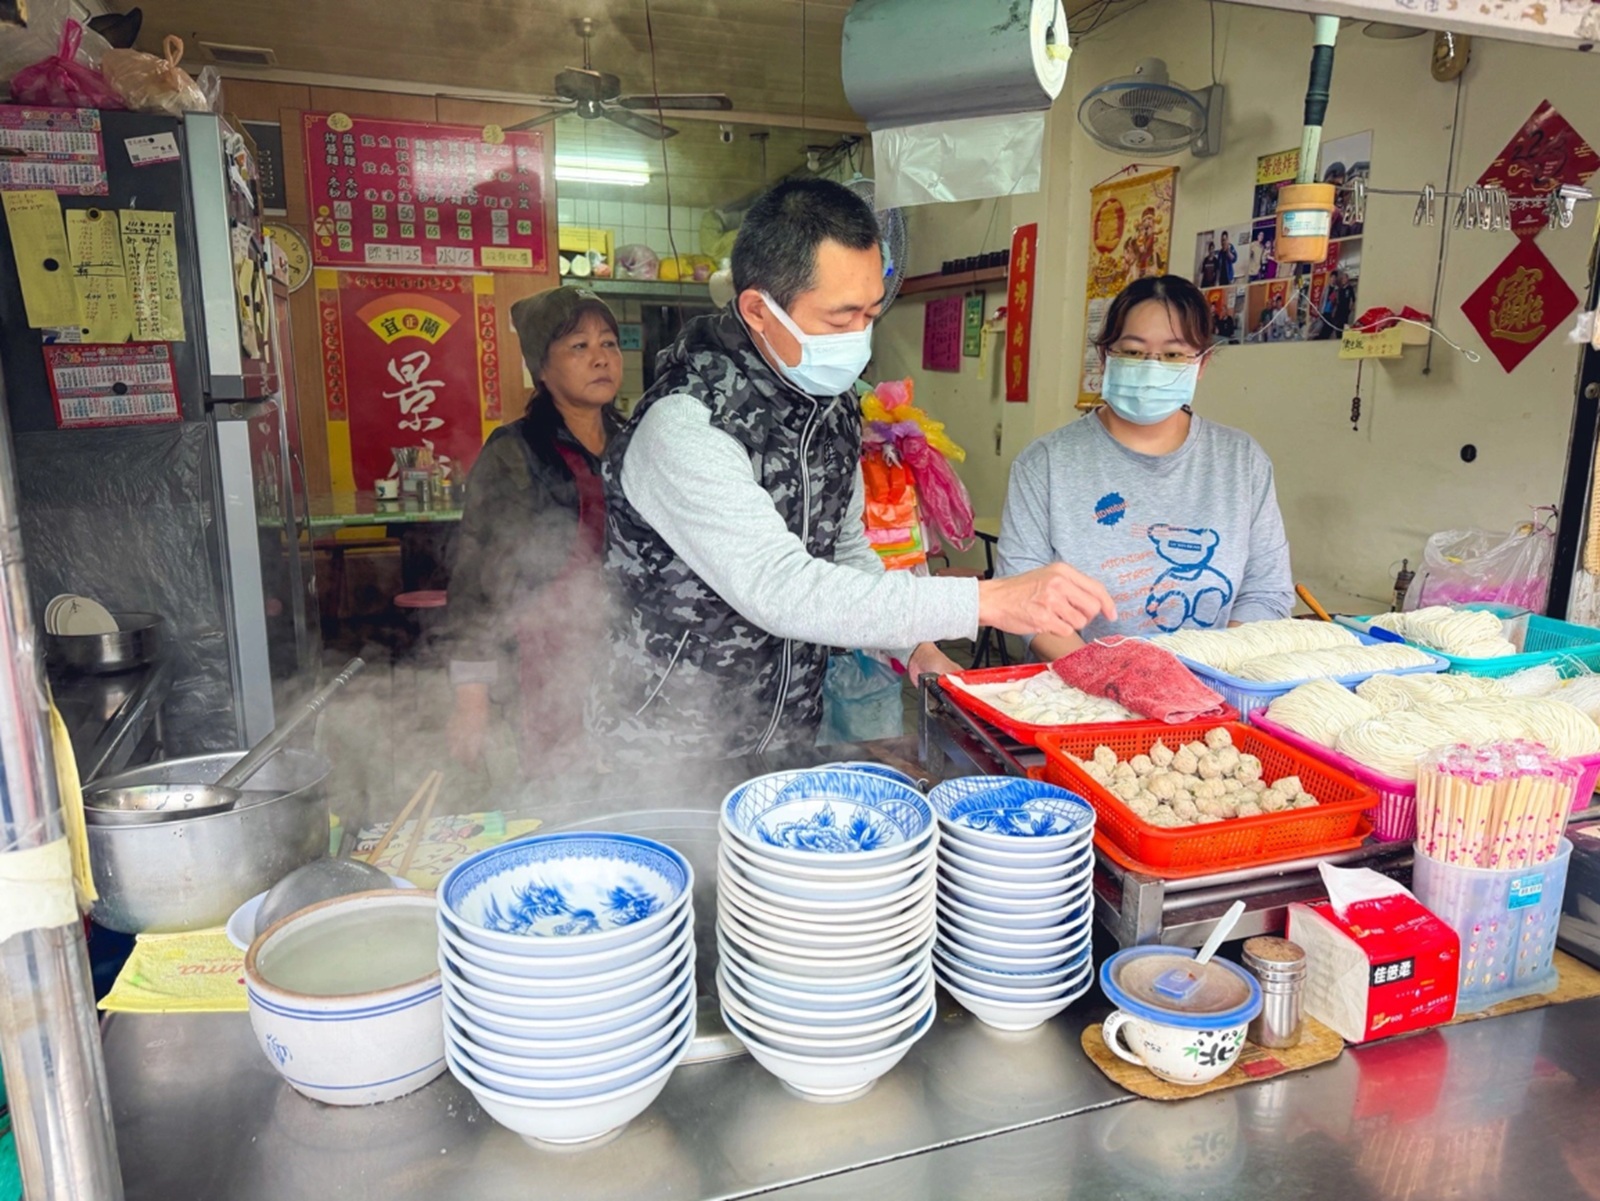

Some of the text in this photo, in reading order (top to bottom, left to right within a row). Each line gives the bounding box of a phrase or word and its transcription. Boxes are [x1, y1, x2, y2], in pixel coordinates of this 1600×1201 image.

[324, 132, 341, 198] 炸醬麵、冬粉
[342, 133, 358, 199] 麻醬麵、冬粉
[361, 134, 378, 201] 餛飩湯
[378, 136, 395, 202] 魚丸湯
[396, 137, 412, 202] 餛飩魚丸湯
[335, 203, 349, 217] 40
[373, 206, 385, 218] 35
[400, 207, 414, 220] 50
[426, 209, 437, 219] 50
[458, 211, 469, 221] 60
[316, 217, 333, 235] 大
[337, 222, 349, 233] 60
[375, 226, 386, 236] 50
[402, 225, 412, 236] 65
[427, 226, 437, 236] 65
[518, 222, 530, 232] 40
[459, 228, 470, 238] 75
[340, 239, 350, 249] 80
[368, 247, 419, 261] 飲料 25
[438, 249, 455, 264] 水
[458, 251, 471, 263] 15
